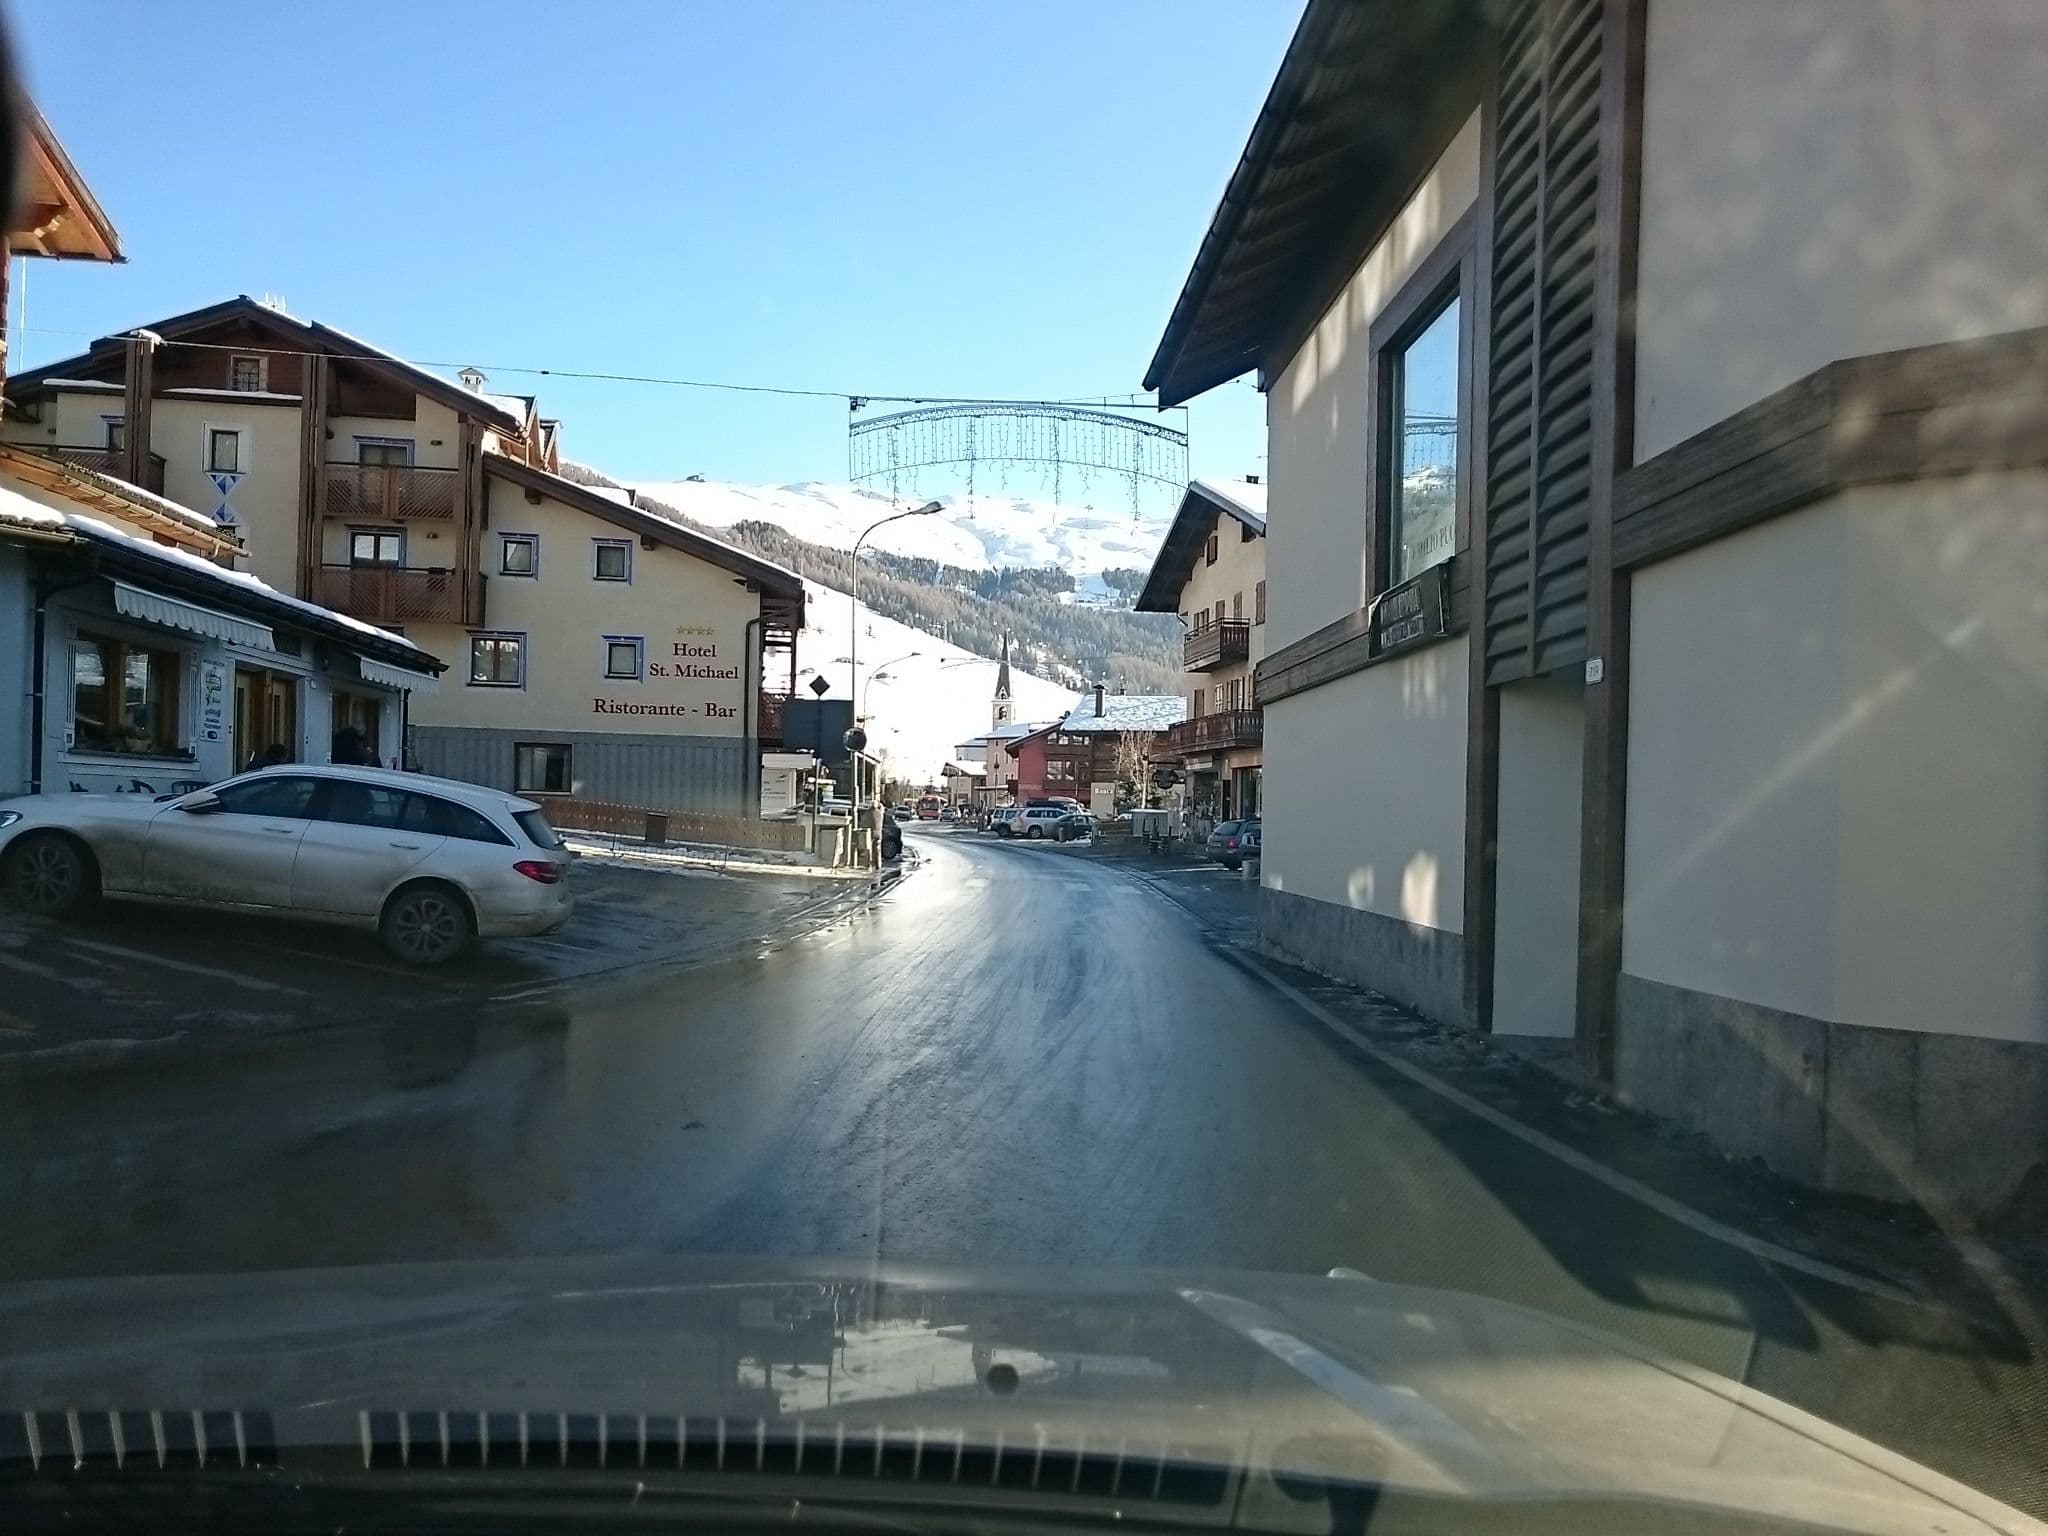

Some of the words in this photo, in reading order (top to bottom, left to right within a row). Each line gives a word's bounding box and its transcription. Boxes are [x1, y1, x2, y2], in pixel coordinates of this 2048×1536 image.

[673, 642, 717, 658] Hotel
[650, 662, 670, 677] St.
[675, 663, 739, 680] Michael
[593, 698, 686, 716] Ristorante
[704, 702, 737, 718] Bar
